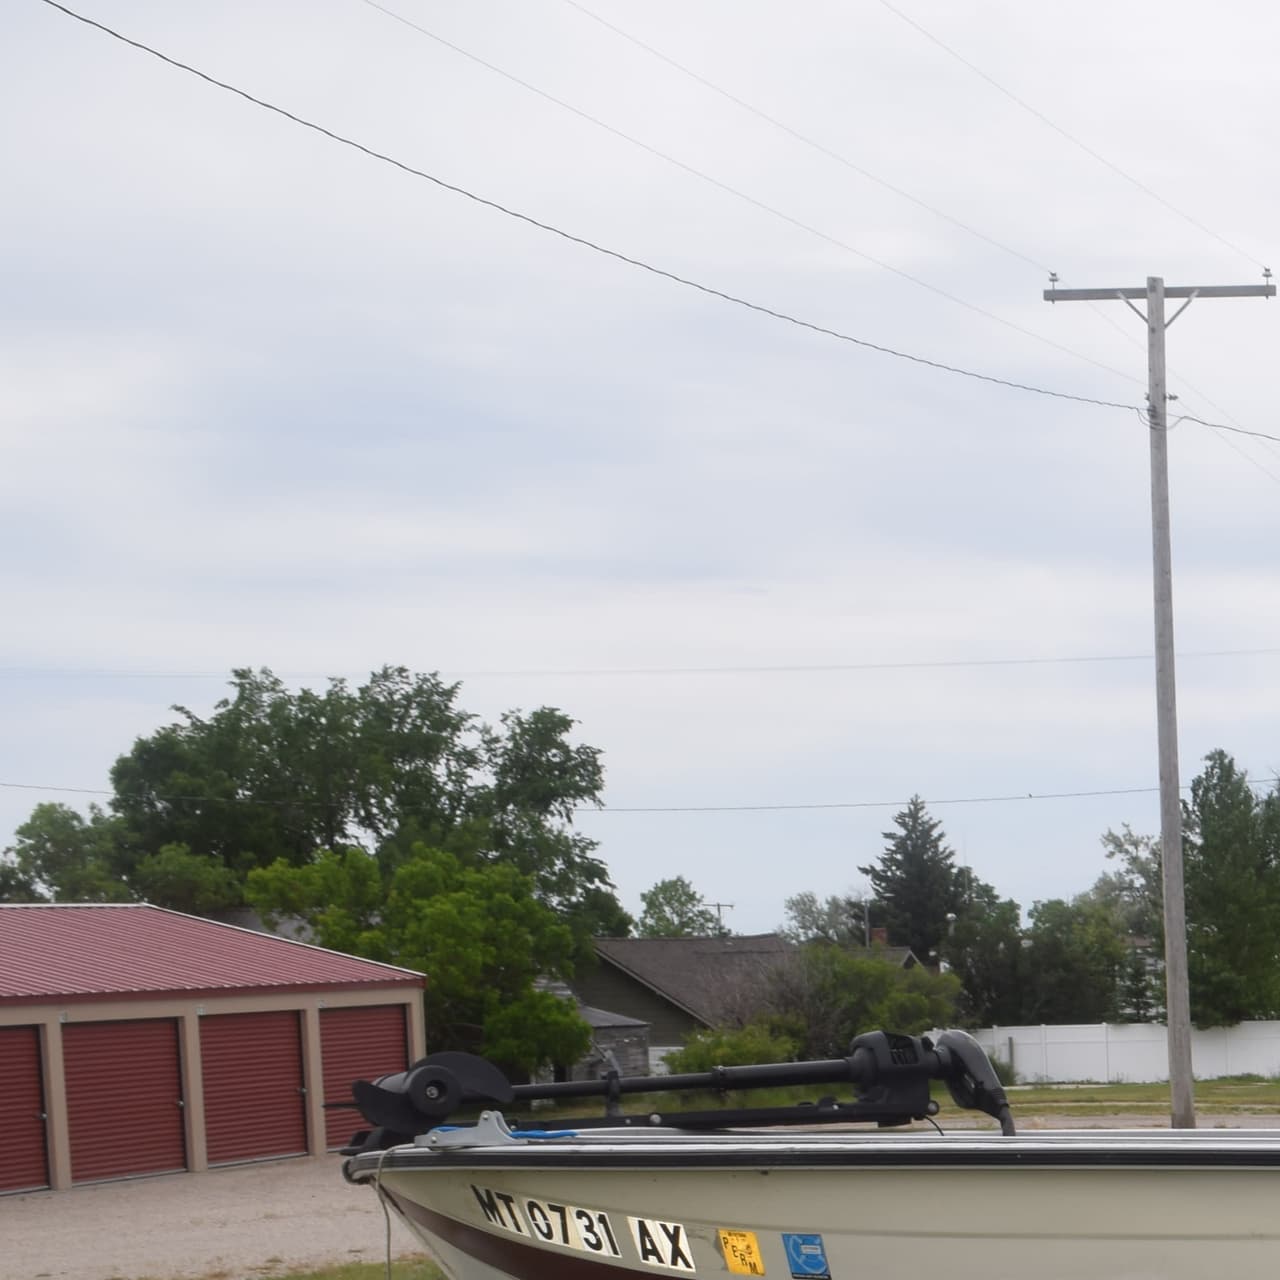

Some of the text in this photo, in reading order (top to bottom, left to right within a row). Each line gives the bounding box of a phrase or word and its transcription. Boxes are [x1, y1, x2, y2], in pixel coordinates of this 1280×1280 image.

[471, 1184, 693, 1269] MT 0731 AX
